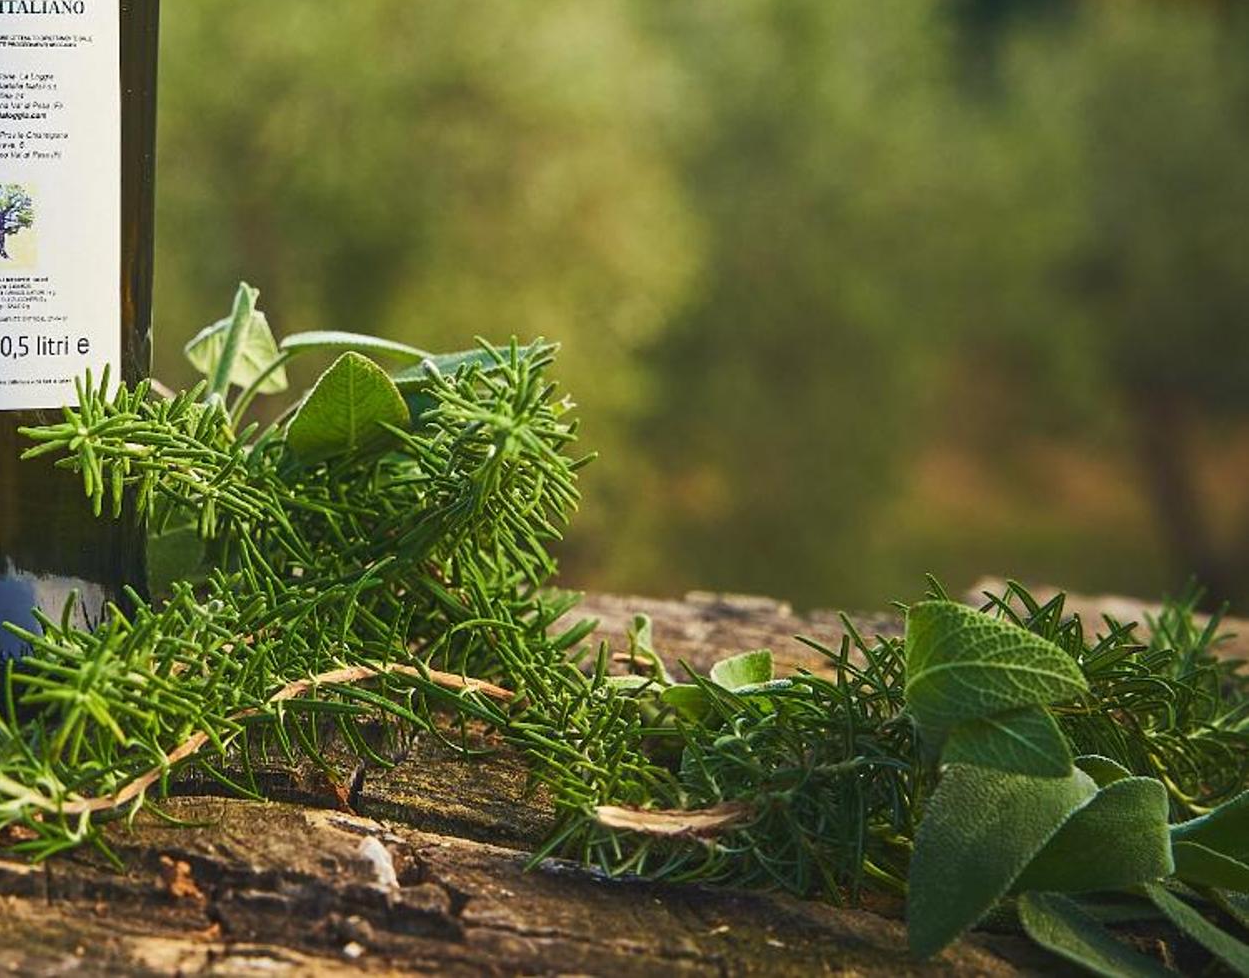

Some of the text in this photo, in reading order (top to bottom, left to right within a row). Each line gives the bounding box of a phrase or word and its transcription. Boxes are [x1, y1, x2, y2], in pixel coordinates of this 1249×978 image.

[0, 336, 29, 360] 0,5
[36, 335, 69, 356] litri
[77, 336, 90, 355] e
